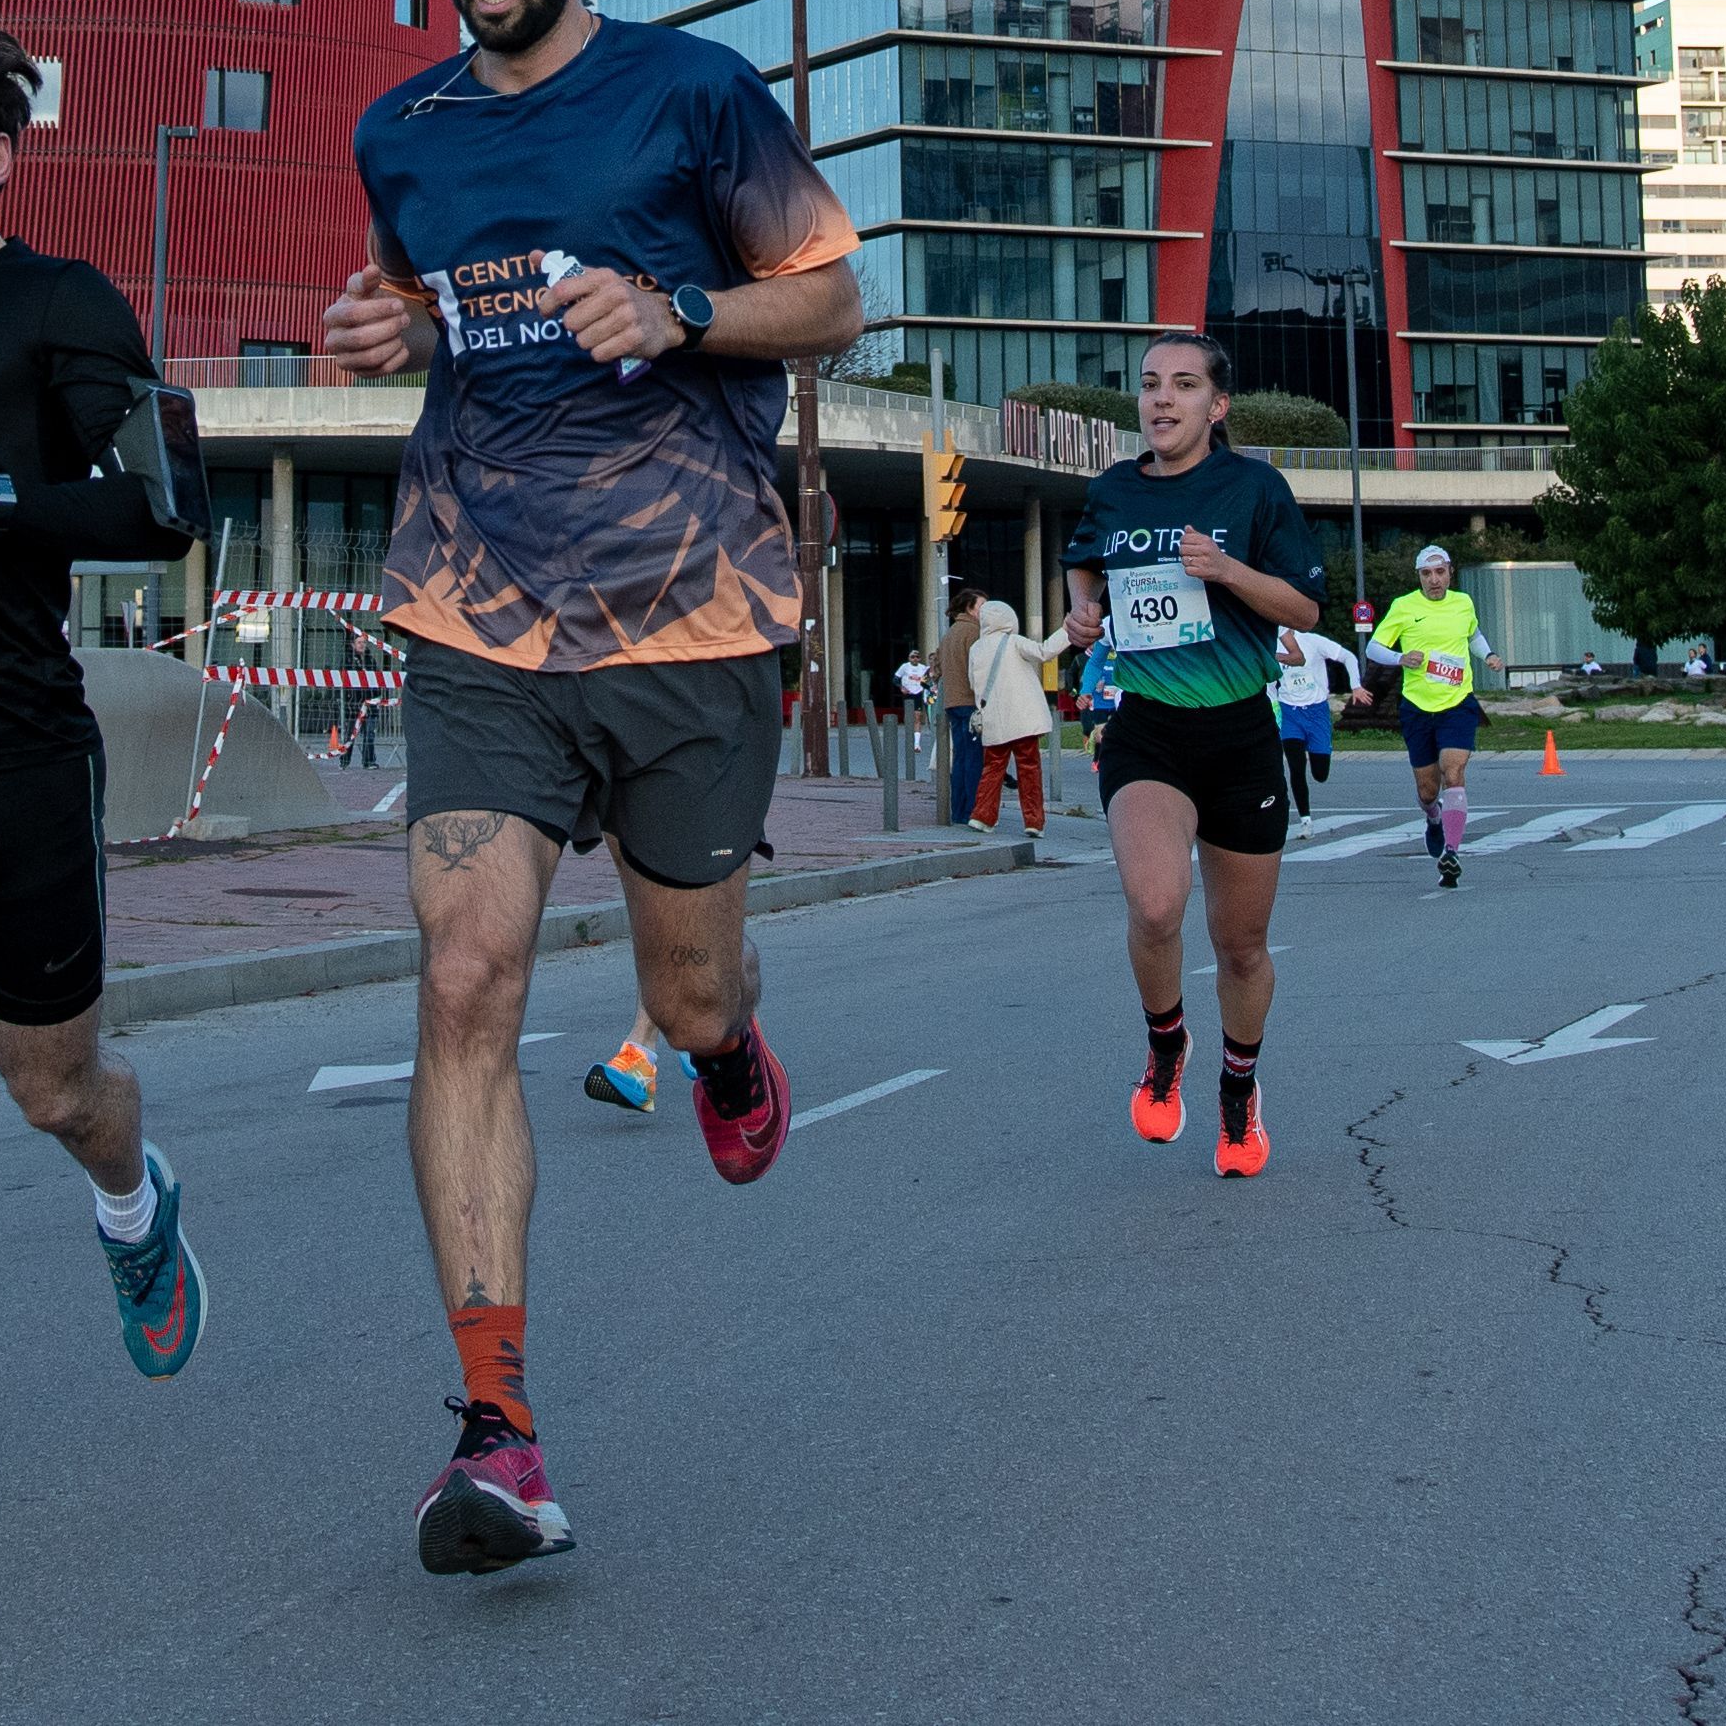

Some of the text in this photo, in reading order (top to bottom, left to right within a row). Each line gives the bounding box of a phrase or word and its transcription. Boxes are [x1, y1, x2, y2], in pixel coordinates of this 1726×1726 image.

[466, 327, 512, 350] DEL
[1004, 399, 1117, 470] HOTEL PORTA FIRA
[1103, 528, 1228, 557] LIPOTRE
[1130, 577, 1157, 587] CURSA
[1135, 582, 1179, 594] EMPRESES
[1130, 595, 1179, 624] 430
[1178, 620, 1215, 645] 5K
[1435, 663, 1459, 677] 1071
